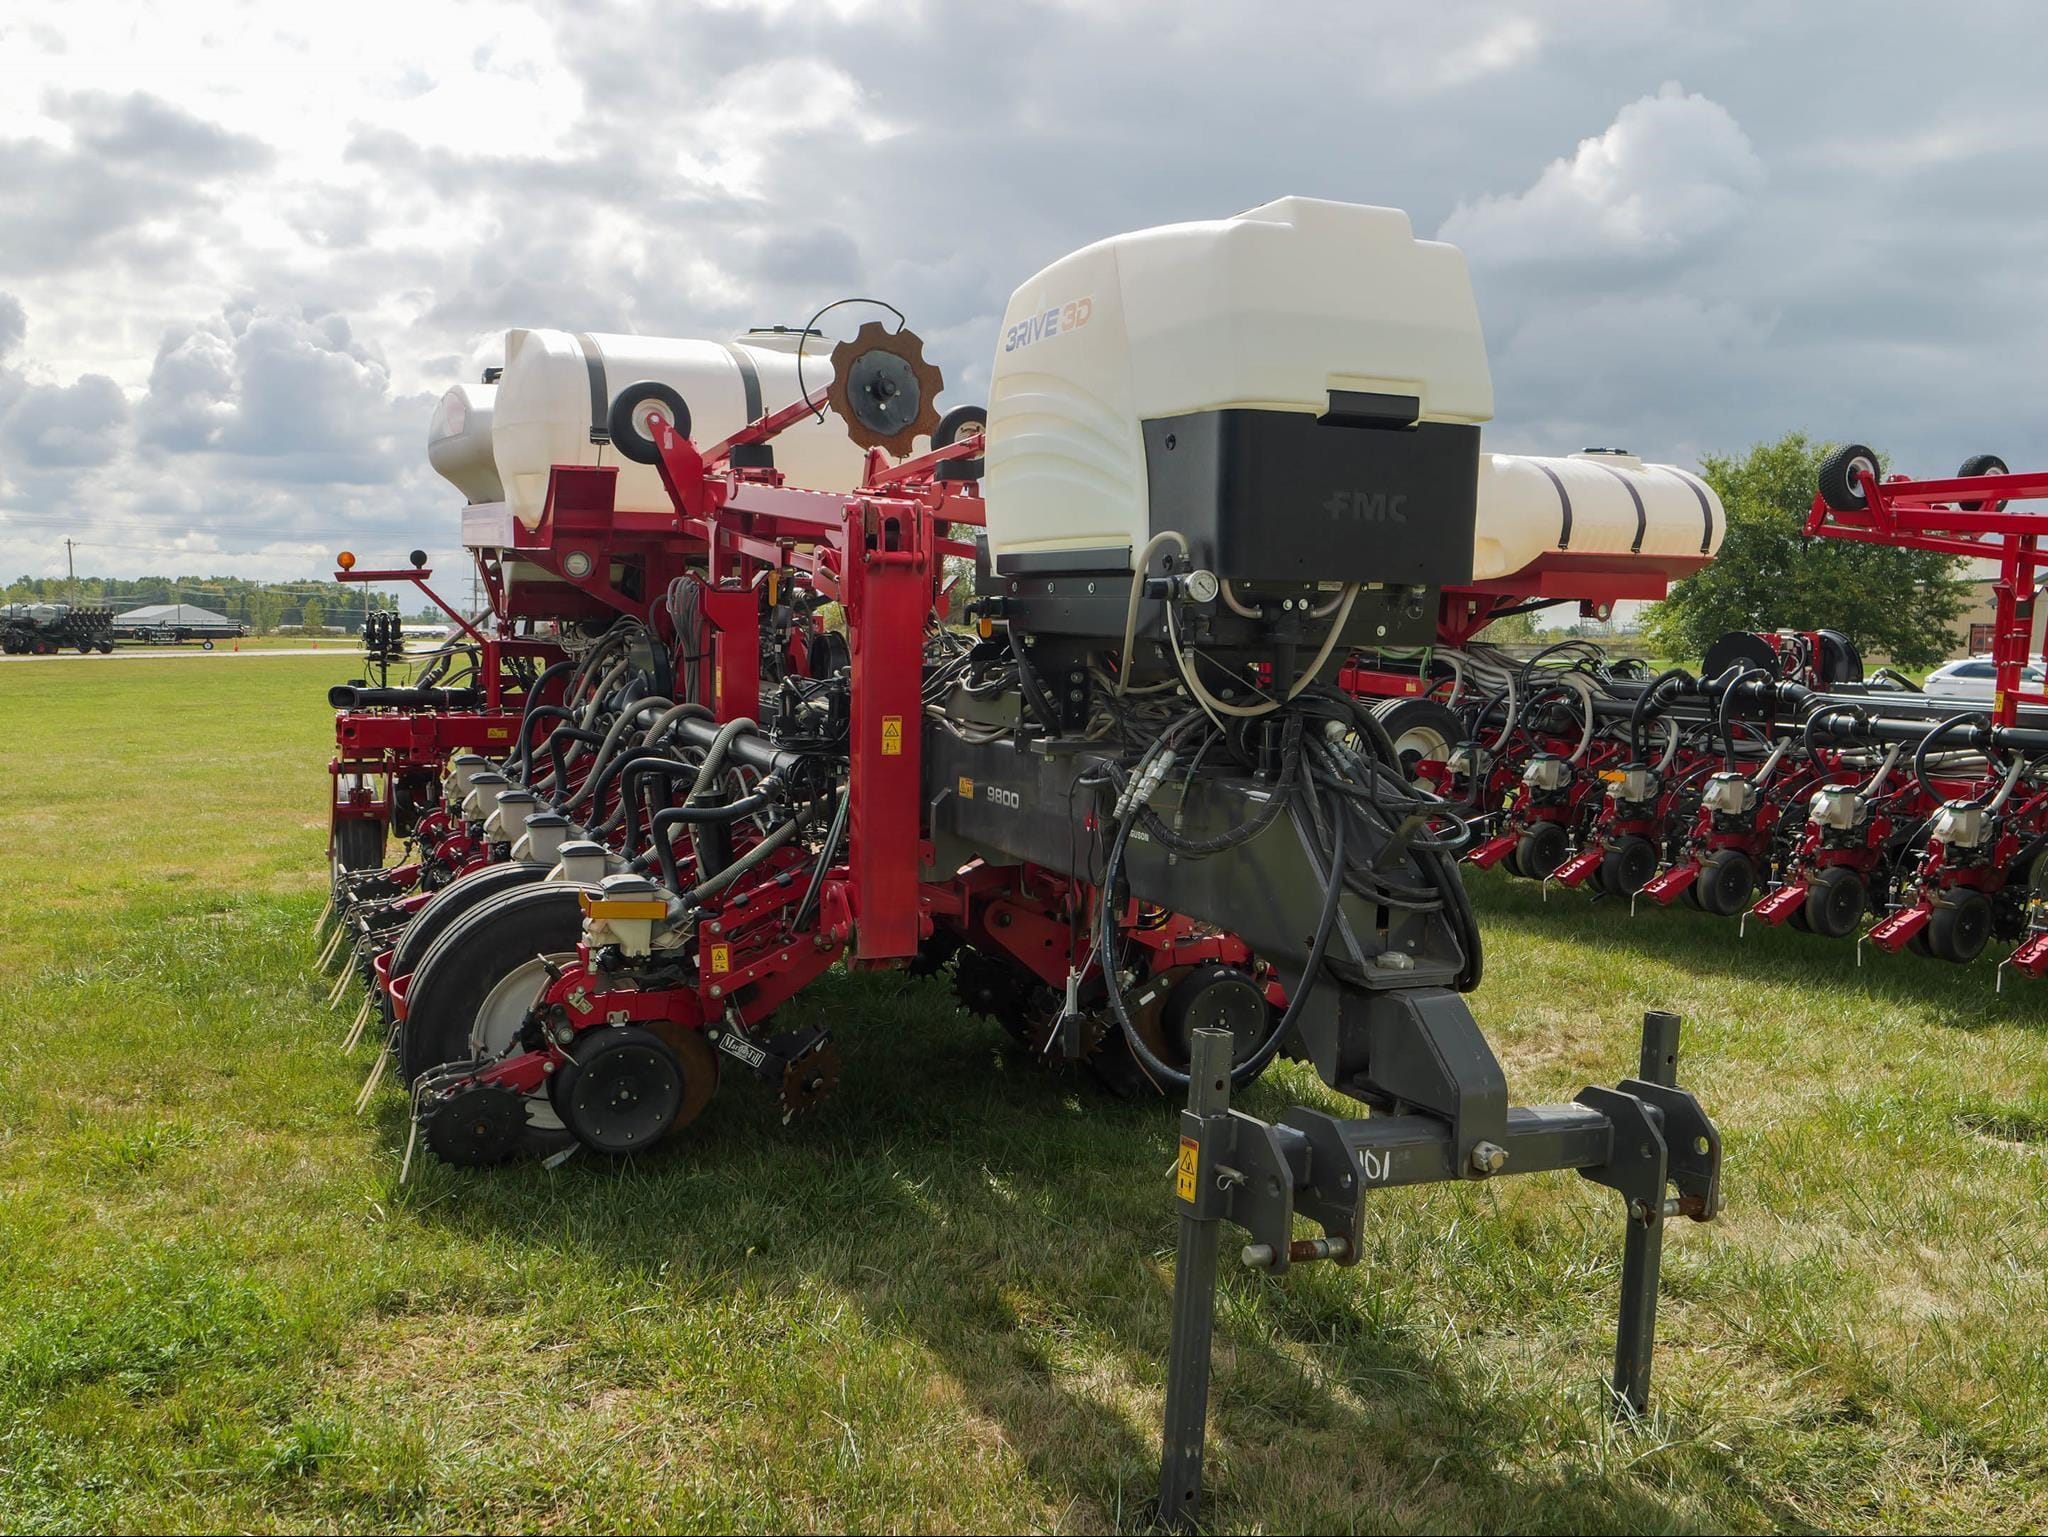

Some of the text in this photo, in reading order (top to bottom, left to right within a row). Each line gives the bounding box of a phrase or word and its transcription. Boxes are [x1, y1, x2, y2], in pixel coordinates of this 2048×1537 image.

[1006, 297, 1092, 352] 3RIVE 3D
[1322, 491, 1408, 522] FMC
[986, 786, 1020, 809] 9800
[1129, 829, 1149, 842] GUSON
